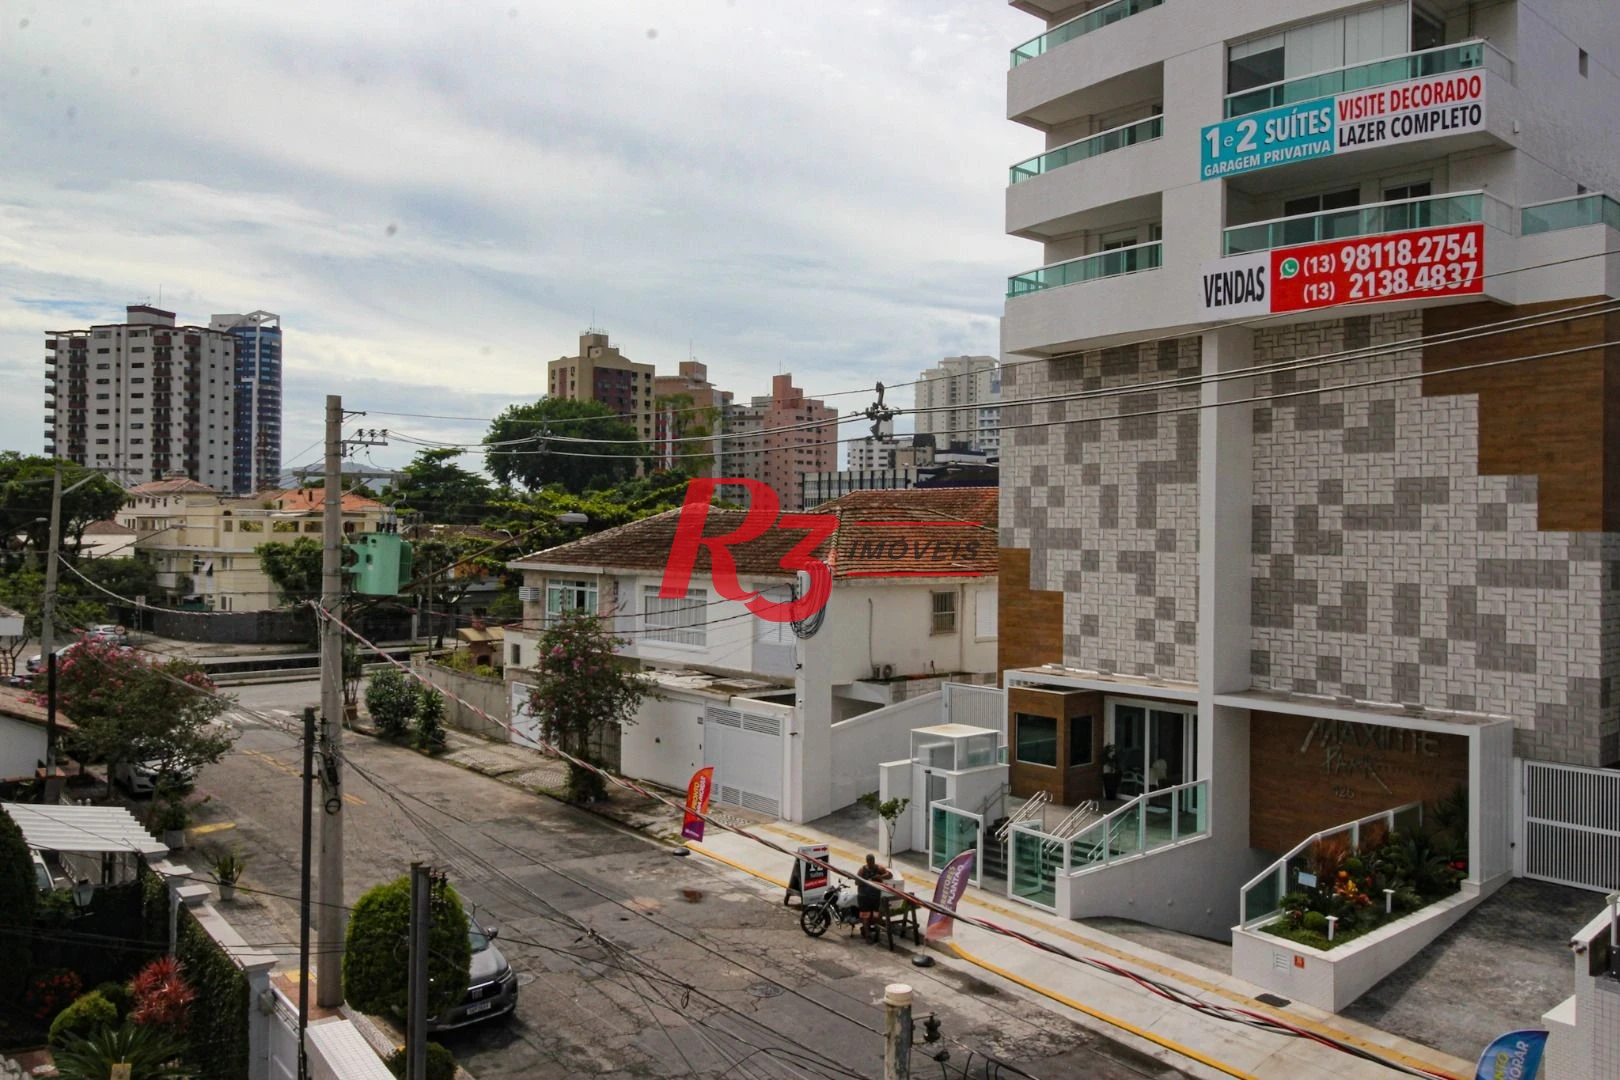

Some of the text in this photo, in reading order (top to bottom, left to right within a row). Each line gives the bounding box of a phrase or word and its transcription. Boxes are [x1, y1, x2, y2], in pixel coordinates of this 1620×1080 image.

[1338, 75, 1482, 121] VISITE DECORADO
[1205, 108, 1332, 158] 1 e 2 SUÍTES
[1339, 104, 1482, 147] LAZER COMPLETO
[1204, 140, 1331, 177] GARAGEM PRIVATIVA
[1303, 232, 1477, 277] (13) 98118.2754
[1203, 266, 1265, 308] VENDAS
[1303, 261, 1477, 304] (13) 2138.4837
